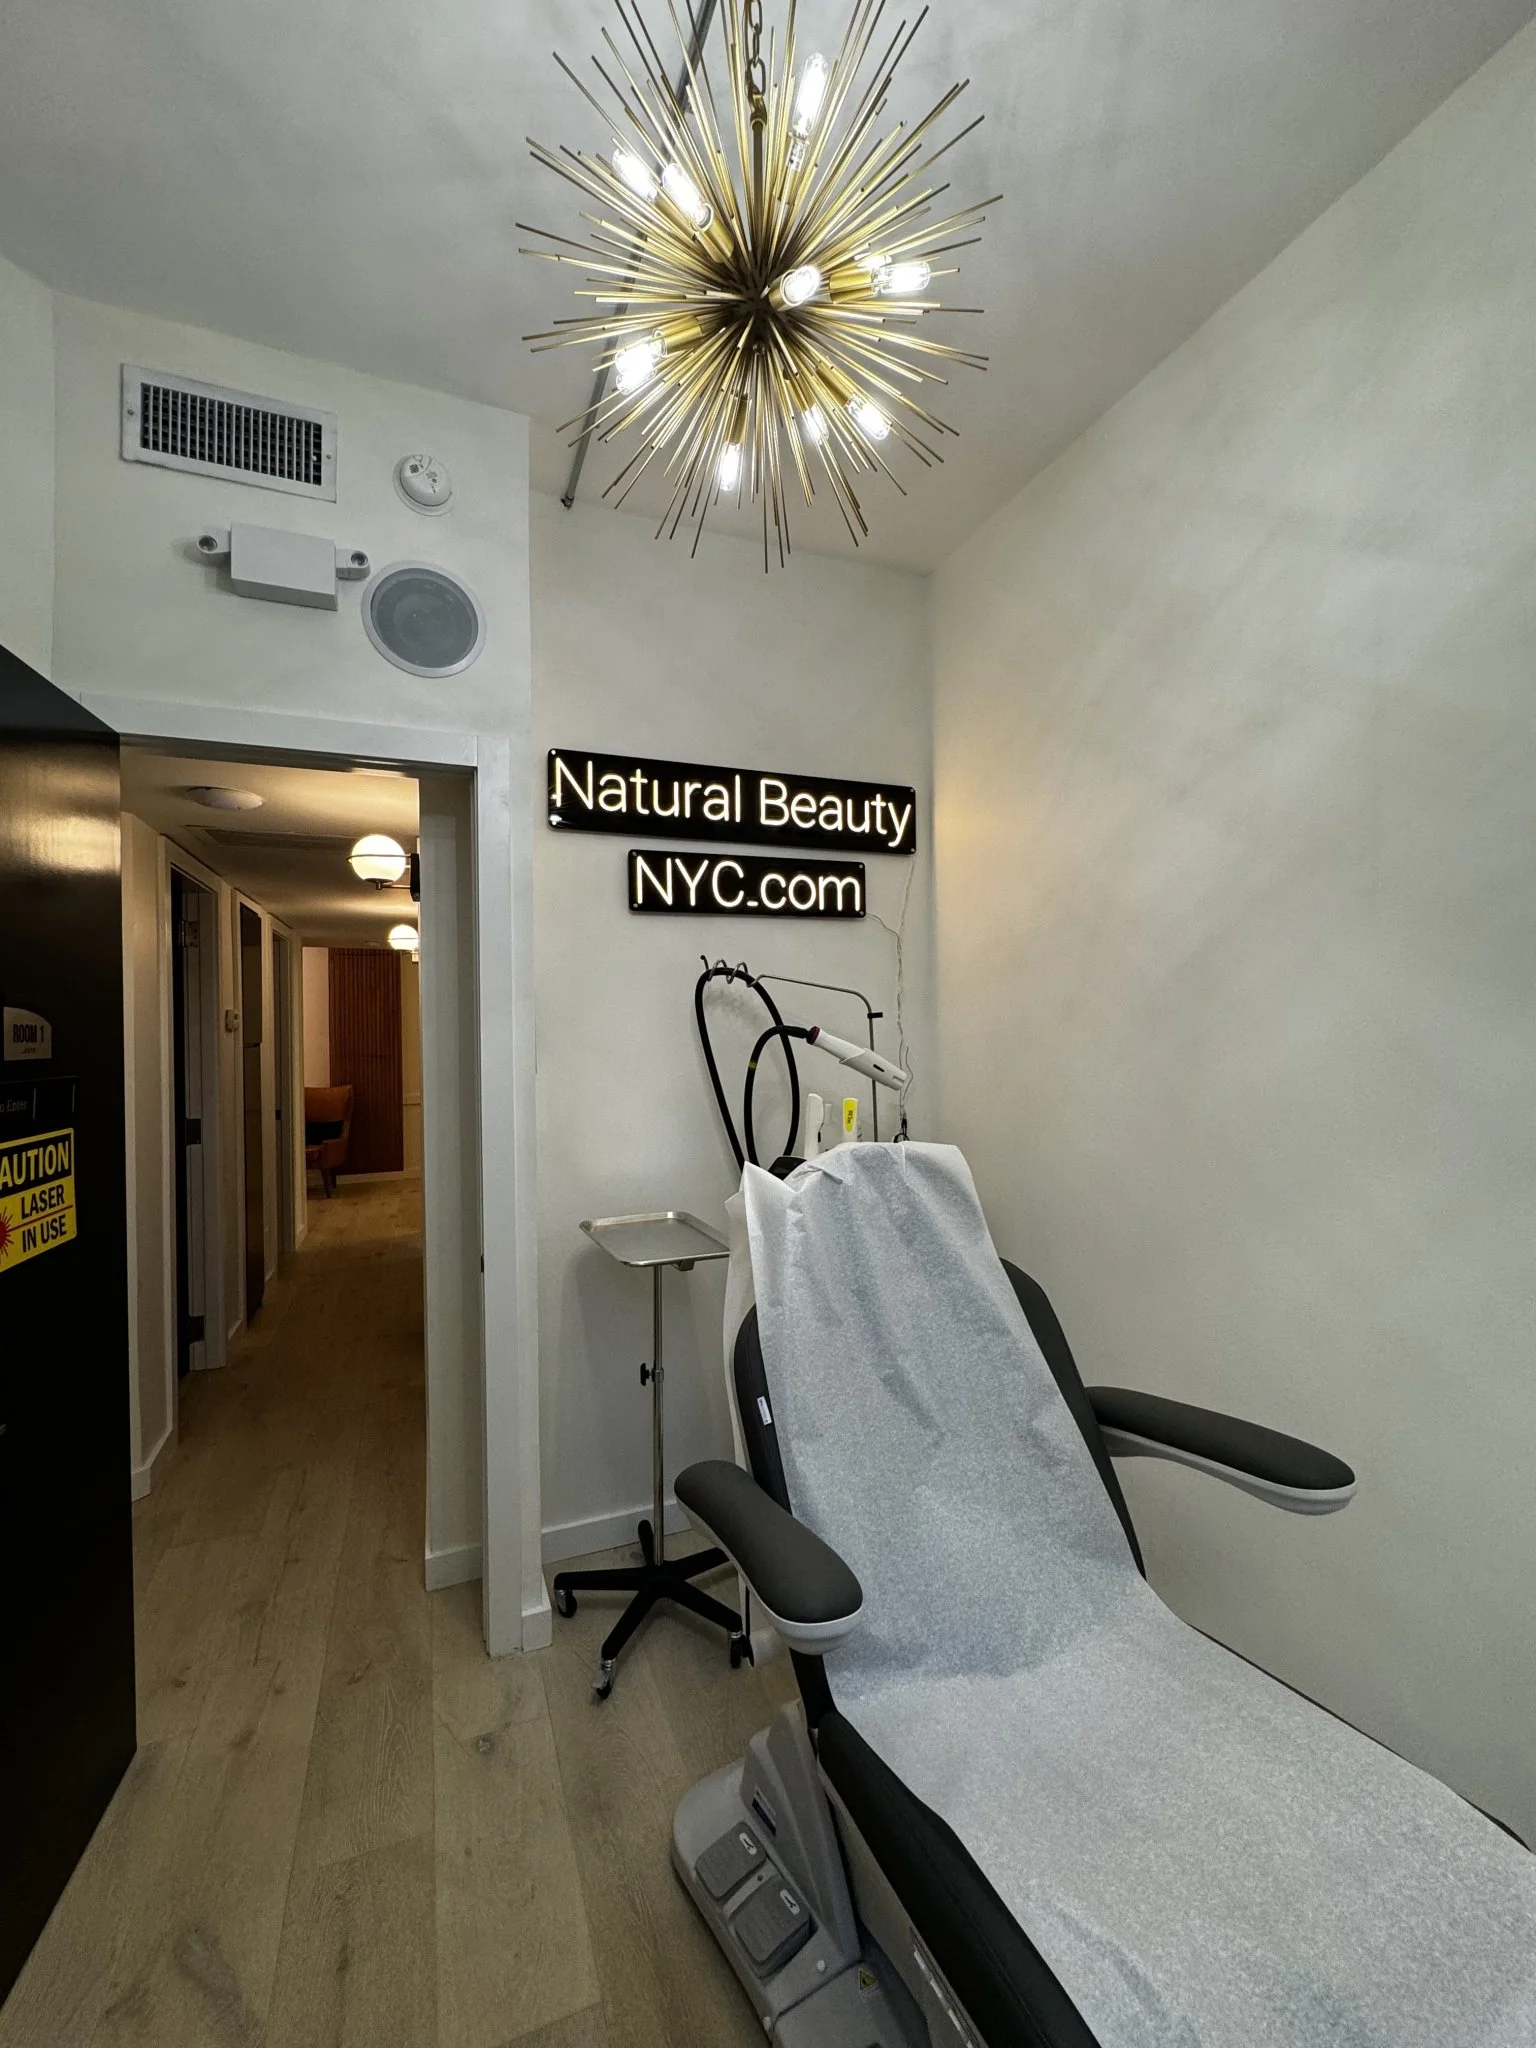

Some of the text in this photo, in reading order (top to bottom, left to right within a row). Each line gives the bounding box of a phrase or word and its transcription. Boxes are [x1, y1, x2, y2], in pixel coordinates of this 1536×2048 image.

[555, 757, 912, 847] Natural Beauty
[636, 855, 861, 912] NYC.com
[13, 1024, 44, 1043] ROOM 1
[21, 1184, 65, 1219] LASER
[22, 1214, 66, 1253] IN USE
